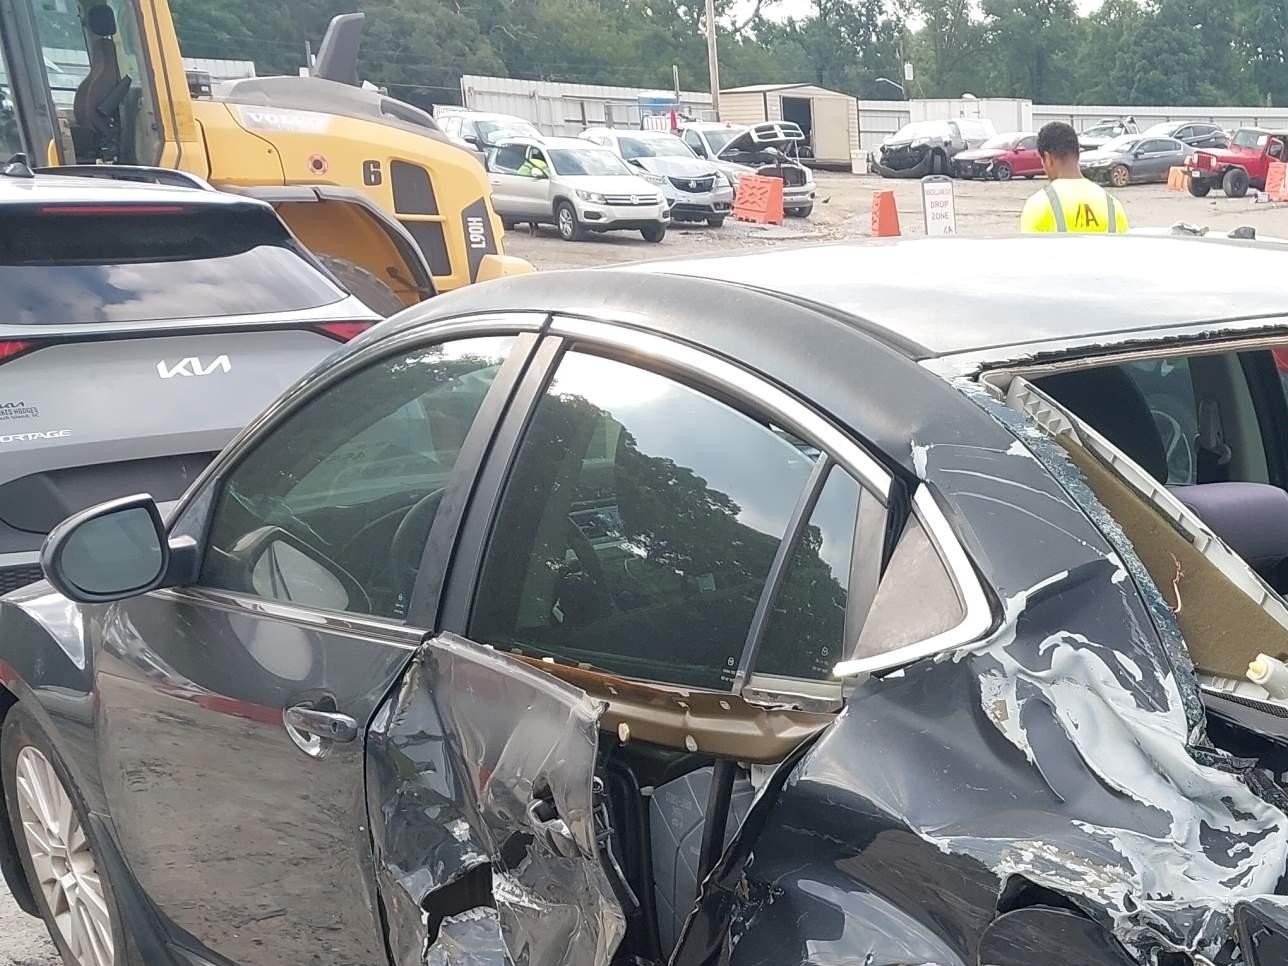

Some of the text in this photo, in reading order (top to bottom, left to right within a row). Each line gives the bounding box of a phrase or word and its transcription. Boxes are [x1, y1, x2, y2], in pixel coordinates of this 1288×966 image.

[363, 160, 382, 186] 6
[930, 200, 949, 208] DROP
[931, 212, 950, 220] ZONE
[467, 217, 486, 249] L90H
[156, 355, 231, 379] KIA
[0, 429, 73, 443] ORTAGE
